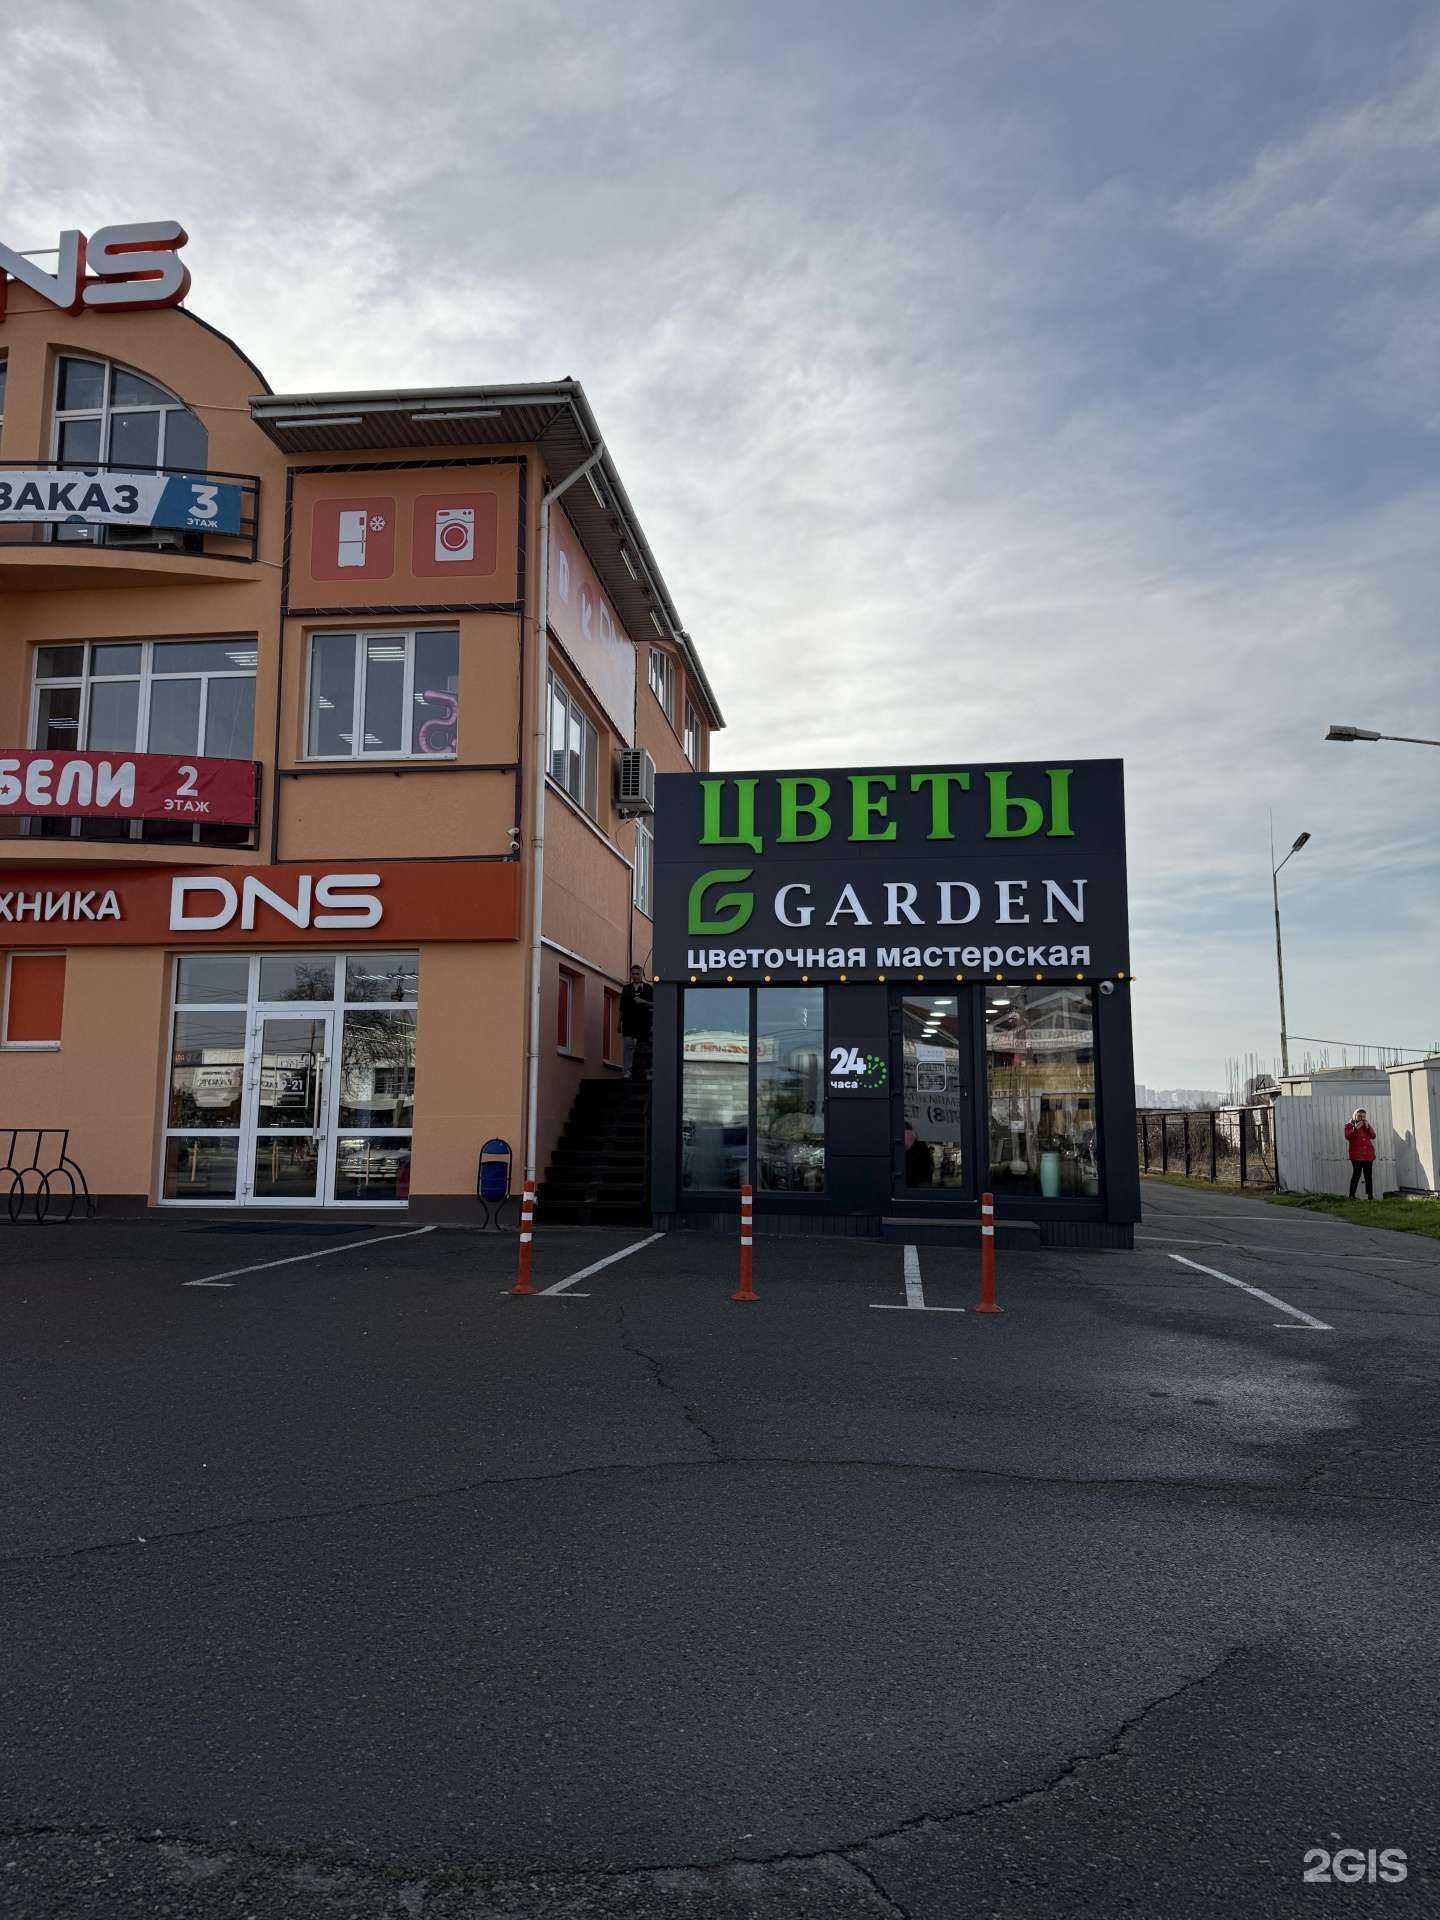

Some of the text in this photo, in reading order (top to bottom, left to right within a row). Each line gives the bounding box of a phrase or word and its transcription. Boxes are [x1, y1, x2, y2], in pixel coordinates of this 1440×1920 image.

[188, 484, 218, 519] 3
[186, 517, 218, 528] ЭТАЖ
[176, 765, 199, 797] 2
[164, 799, 209, 813] ЭТАЖ
[699, 769, 1075, 853] ЦВЕТЫ
[0, 890, 121, 922] ХНИКА
[169, 873, 383, 931] DNS
[774, 879, 1088, 928] GARDEN
[688, 944, 1091, 973] цветочная мастерская
[830, 1046, 867, 1075] 24
[830, 1080, 858, 1089] часа
